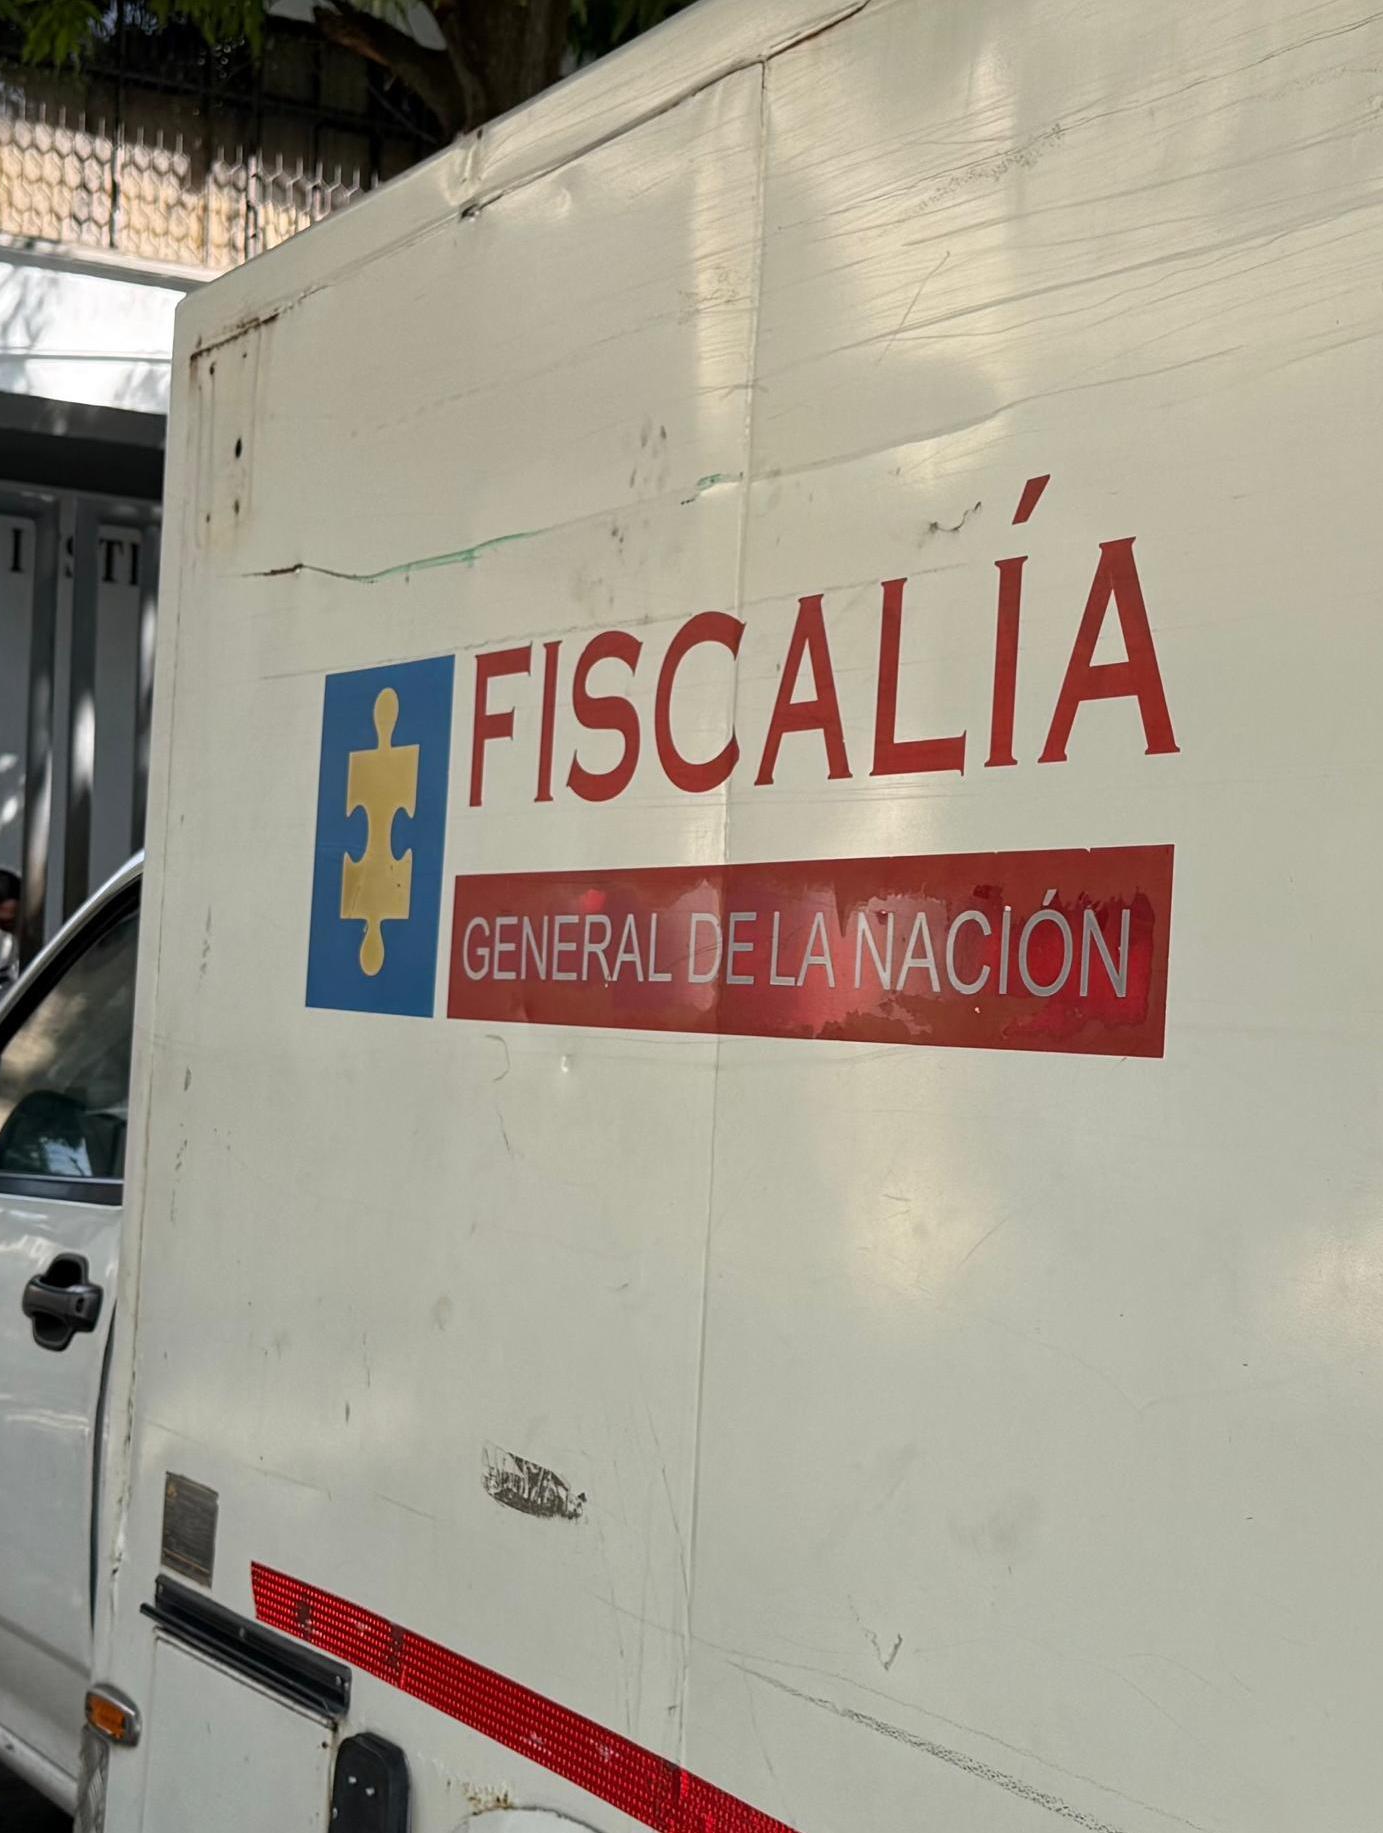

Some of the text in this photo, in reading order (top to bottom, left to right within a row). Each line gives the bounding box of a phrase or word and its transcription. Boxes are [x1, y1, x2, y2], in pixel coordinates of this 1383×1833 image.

[468, 473, 1181, 807] FISCALÍA
[462, 888, 1131, 998] GENERAL DE LA NACIÓN
